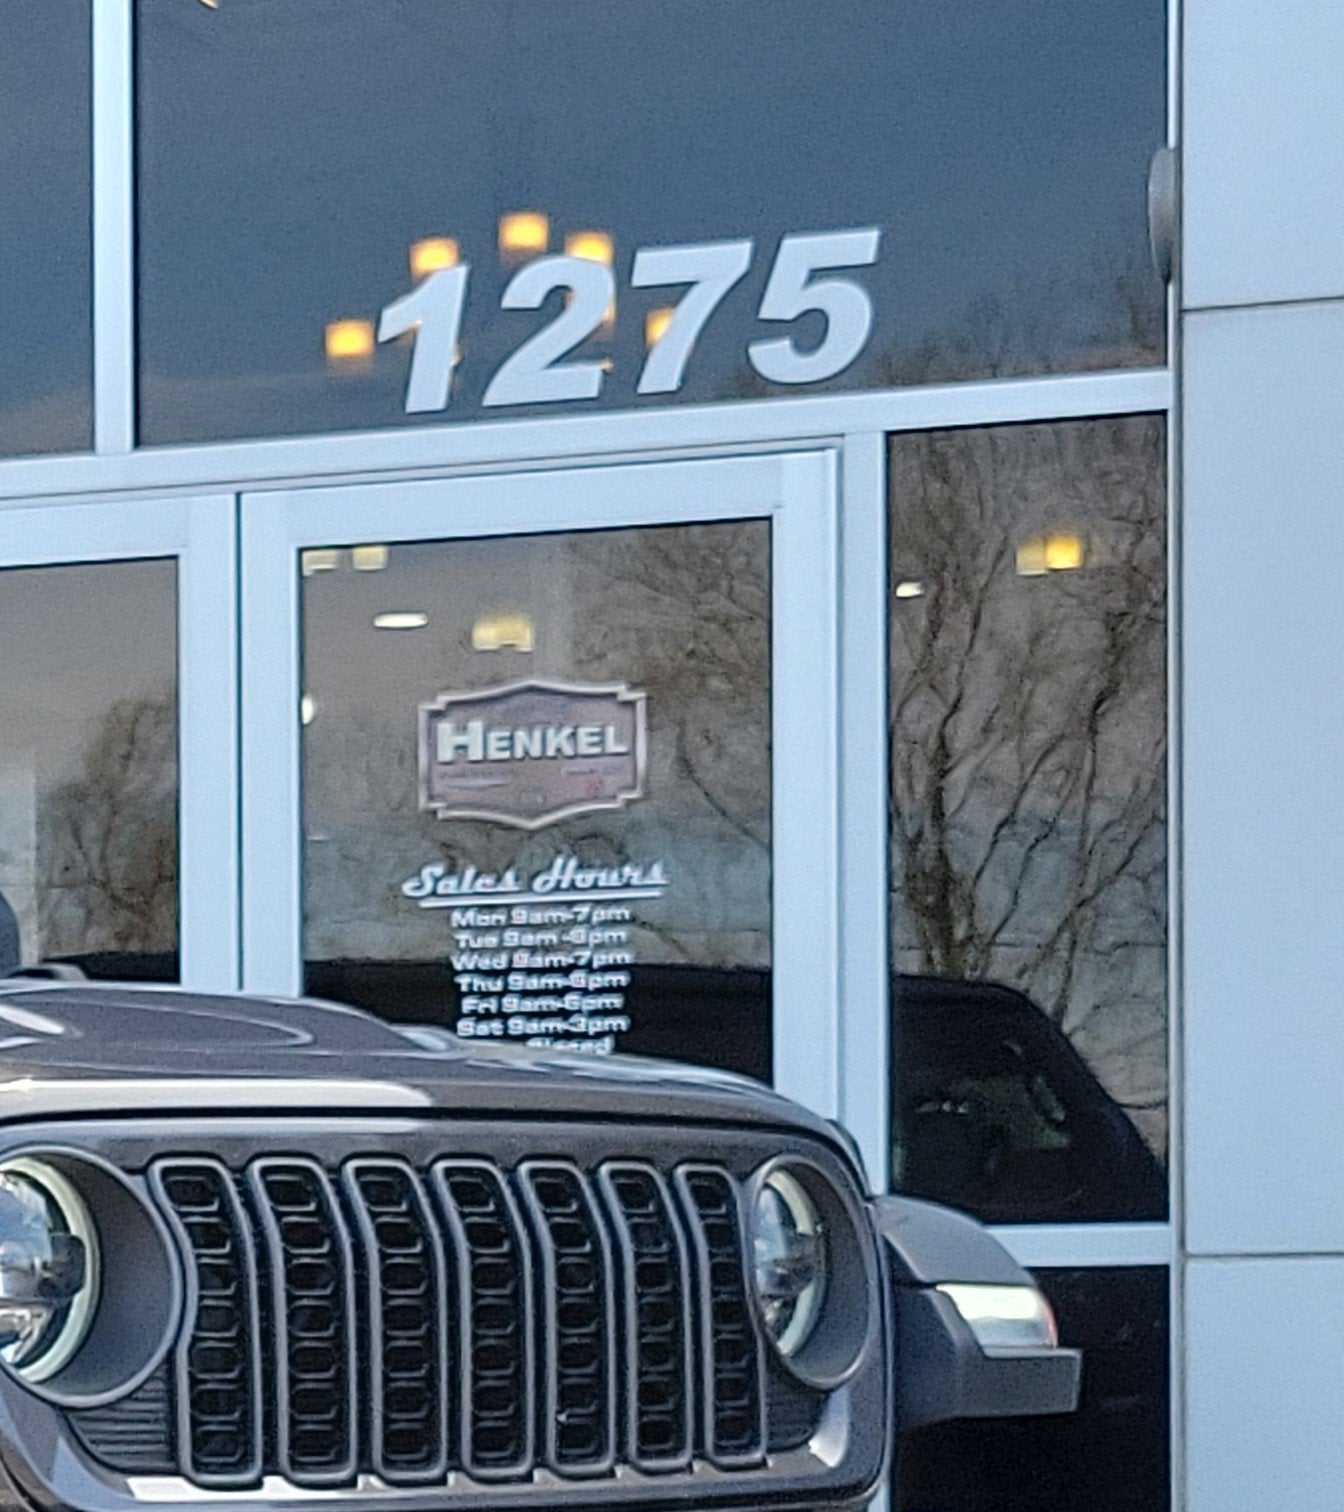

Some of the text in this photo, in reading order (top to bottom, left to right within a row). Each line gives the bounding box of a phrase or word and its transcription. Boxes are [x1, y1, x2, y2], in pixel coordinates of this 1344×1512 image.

[376, 227, 881, 414] 1275
[402, 855, 670, 897] Sales Hours
[451, 908, 506, 927] Mon
[455, 931, 498, 949] Tue
[450, 953, 508, 971] Wed
[454, 974, 504, 992] Thu
[462, 997, 498, 1014] Fri
[456, 1018, 504, 1036] Sat
